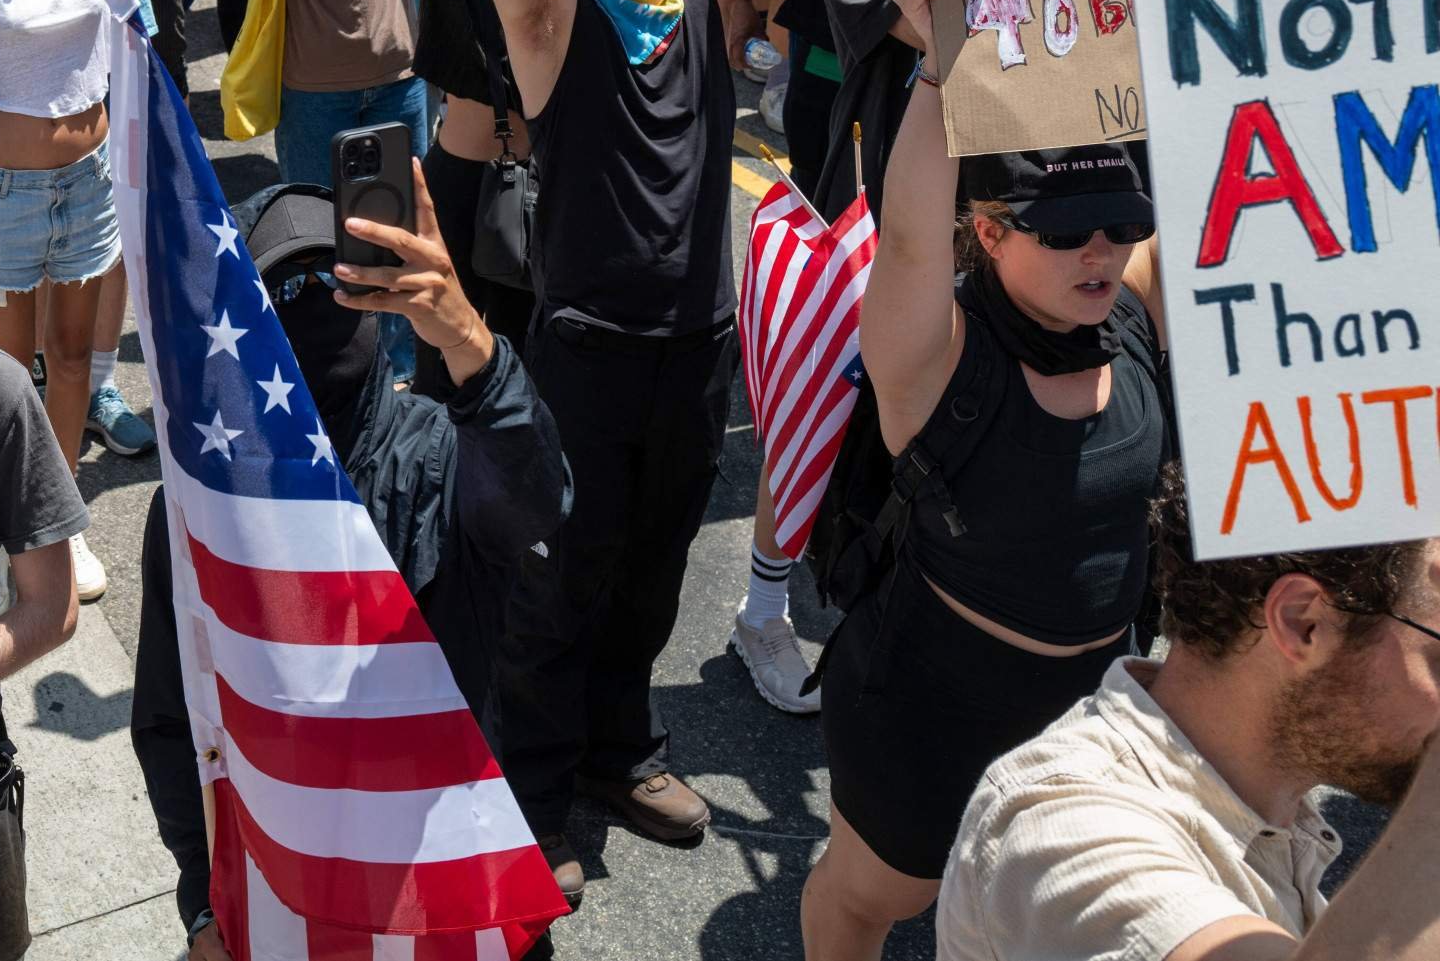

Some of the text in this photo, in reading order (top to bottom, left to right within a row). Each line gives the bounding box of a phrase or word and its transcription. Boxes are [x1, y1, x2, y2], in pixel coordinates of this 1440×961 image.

[1046, 163, 1068, 174] BUT
[1072, 161, 1095, 171] HER
[1194, 282, 1421, 377] Than
